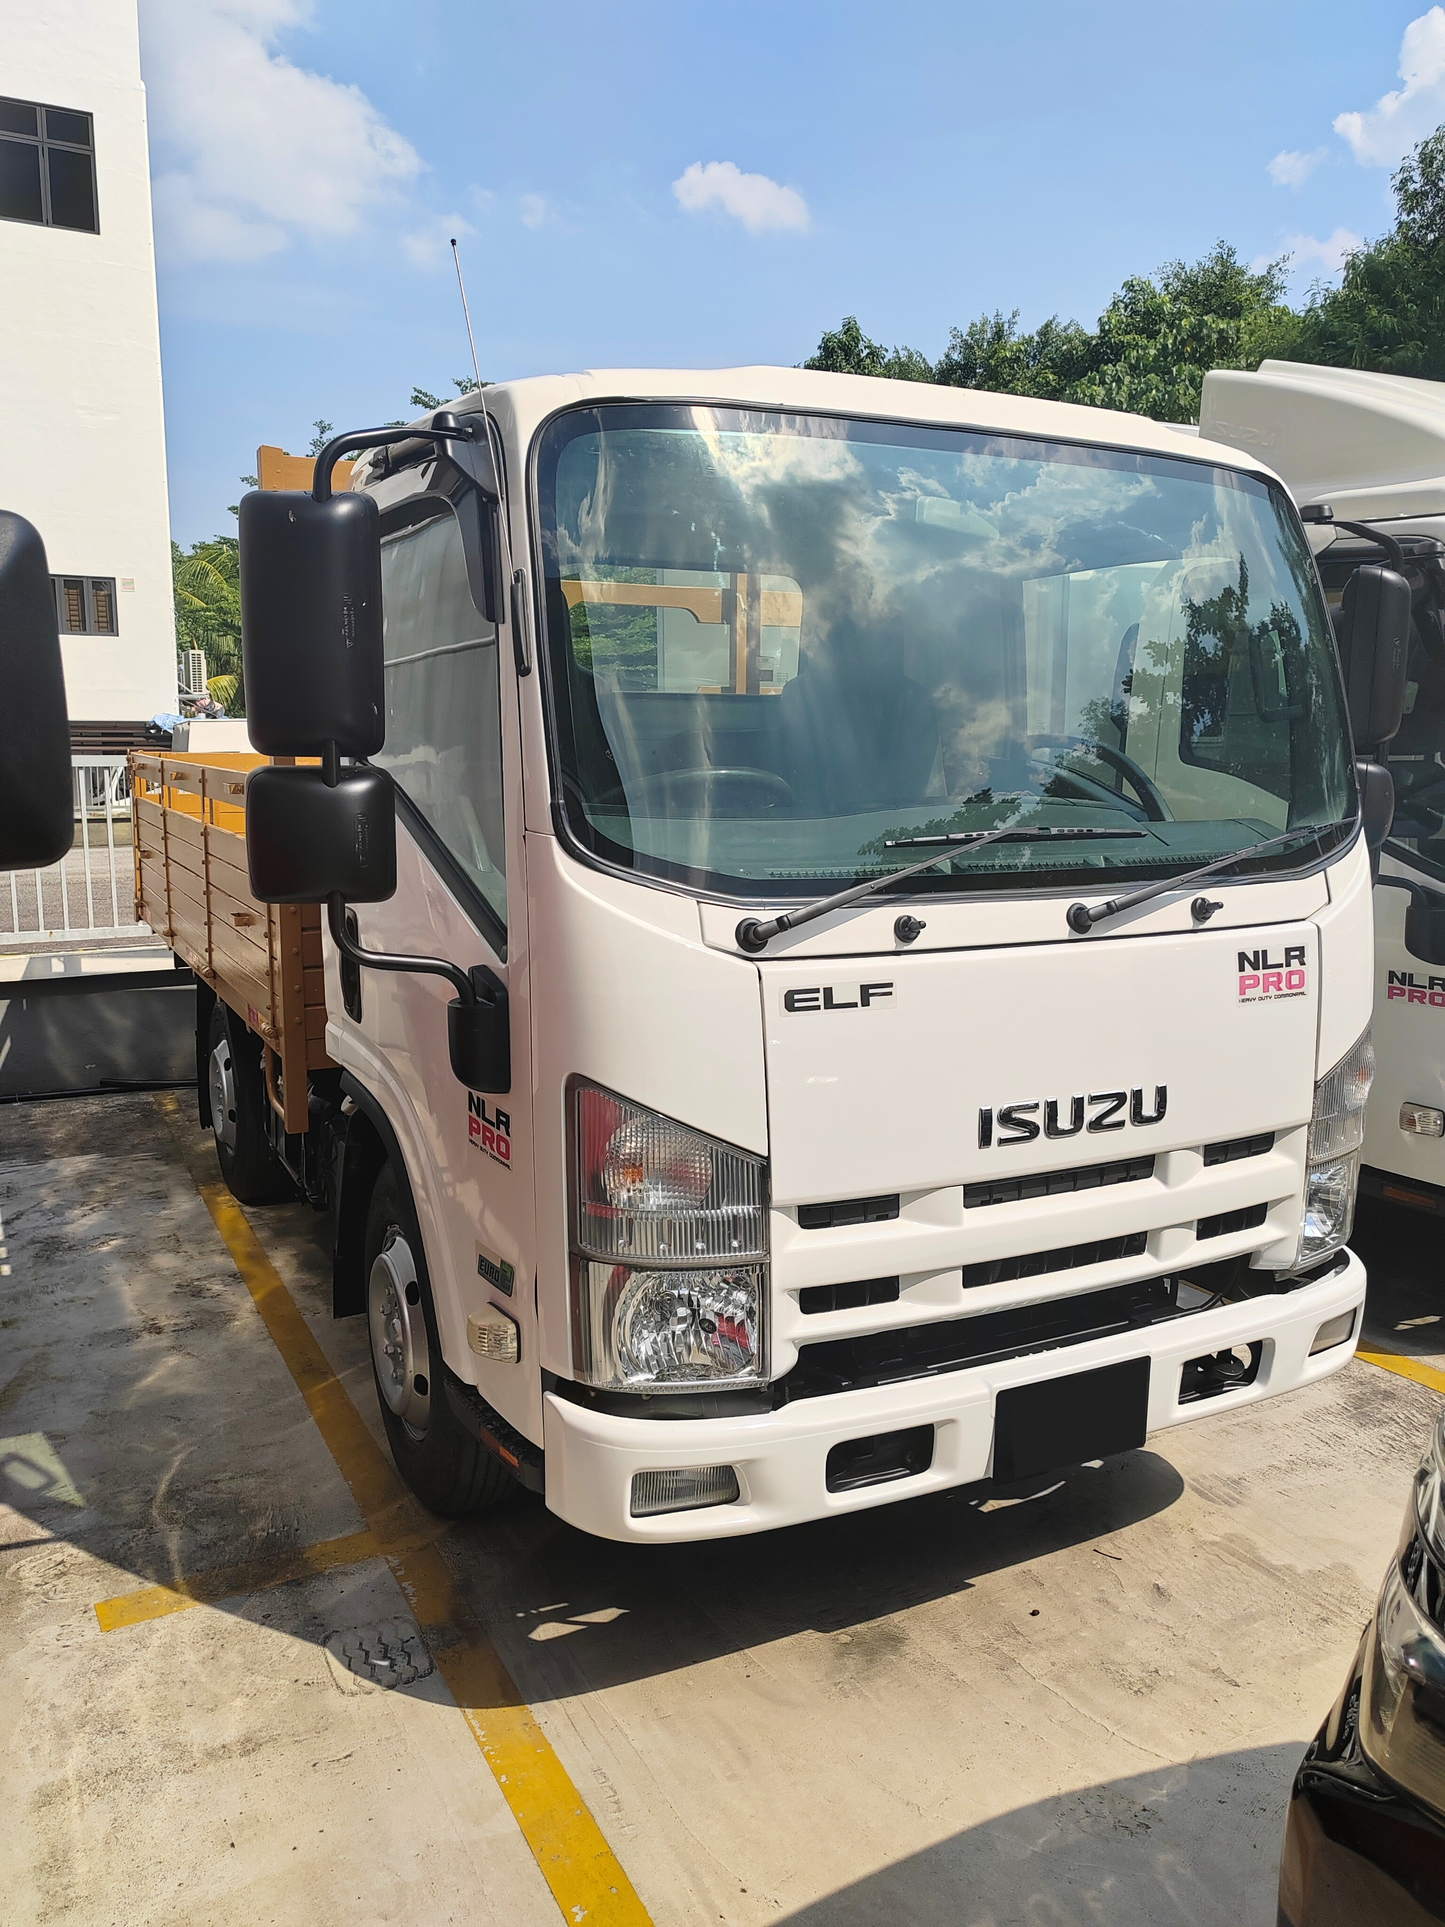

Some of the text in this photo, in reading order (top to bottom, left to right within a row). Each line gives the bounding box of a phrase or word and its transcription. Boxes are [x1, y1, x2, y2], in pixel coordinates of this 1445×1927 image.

[1237, 945, 1306, 973] NLR
[1238, 969, 1305, 996] PRO
[1388, 970, 1445, 992] NLR
[783, 981, 894, 1012] ELF
[1274, 991, 1307, 1000] COMMONRAIL
[1387, 985, 1445, 1007] PRO
[468, 1090, 512, 1138] NLR
[978, 1082, 1168, 1150] ISUZU
[468, 1113, 511, 1161] PRO
[479, 1257, 501, 1284] EURO
